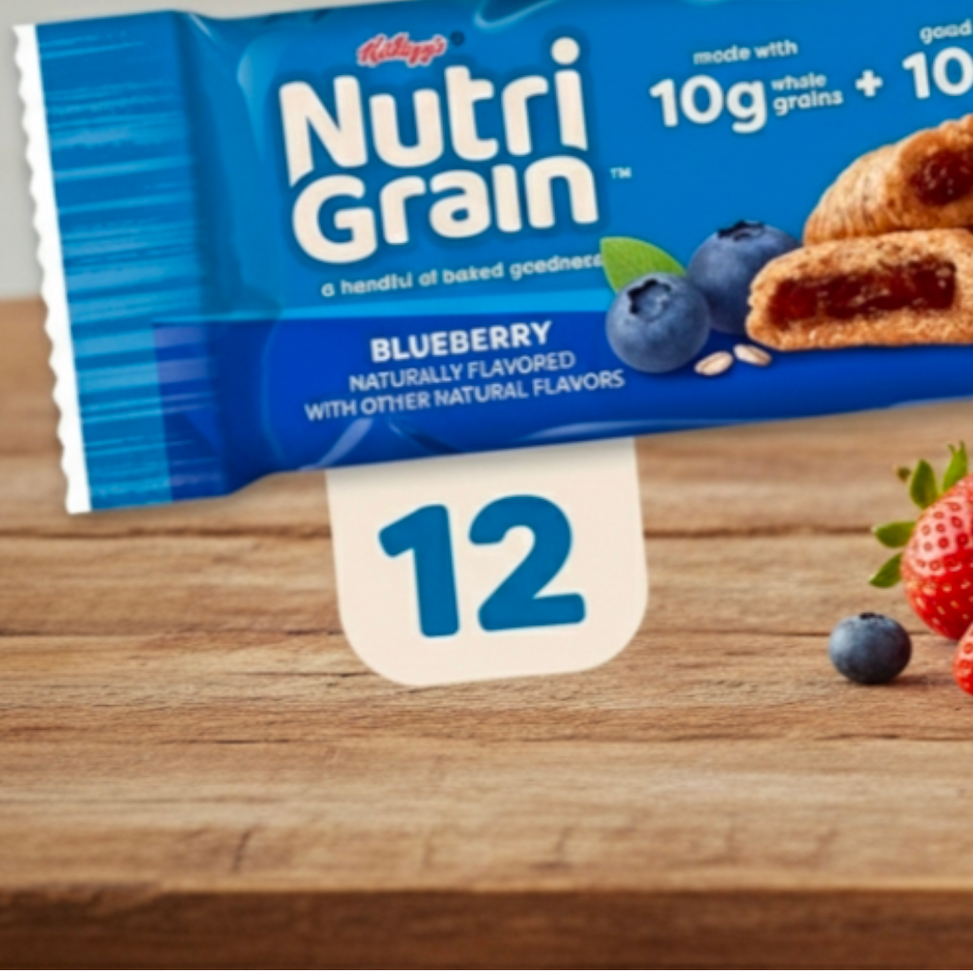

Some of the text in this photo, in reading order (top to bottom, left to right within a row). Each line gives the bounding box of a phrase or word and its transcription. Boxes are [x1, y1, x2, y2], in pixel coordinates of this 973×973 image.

[279, 37, 588, 187] Nutri
[649, 74, 766, 133] 10g
[772, 89, 844, 116] grains
[292, 155, 599, 264] Grain
[370, 320, 552, 363] BLUEBERRY
[304, 370, 625, 422] WITH OTHER NATURAL FLAVORS
[349, 351, 576, 392] NATURALLY FLAVORED
[378, 494, 586, 638] 12
